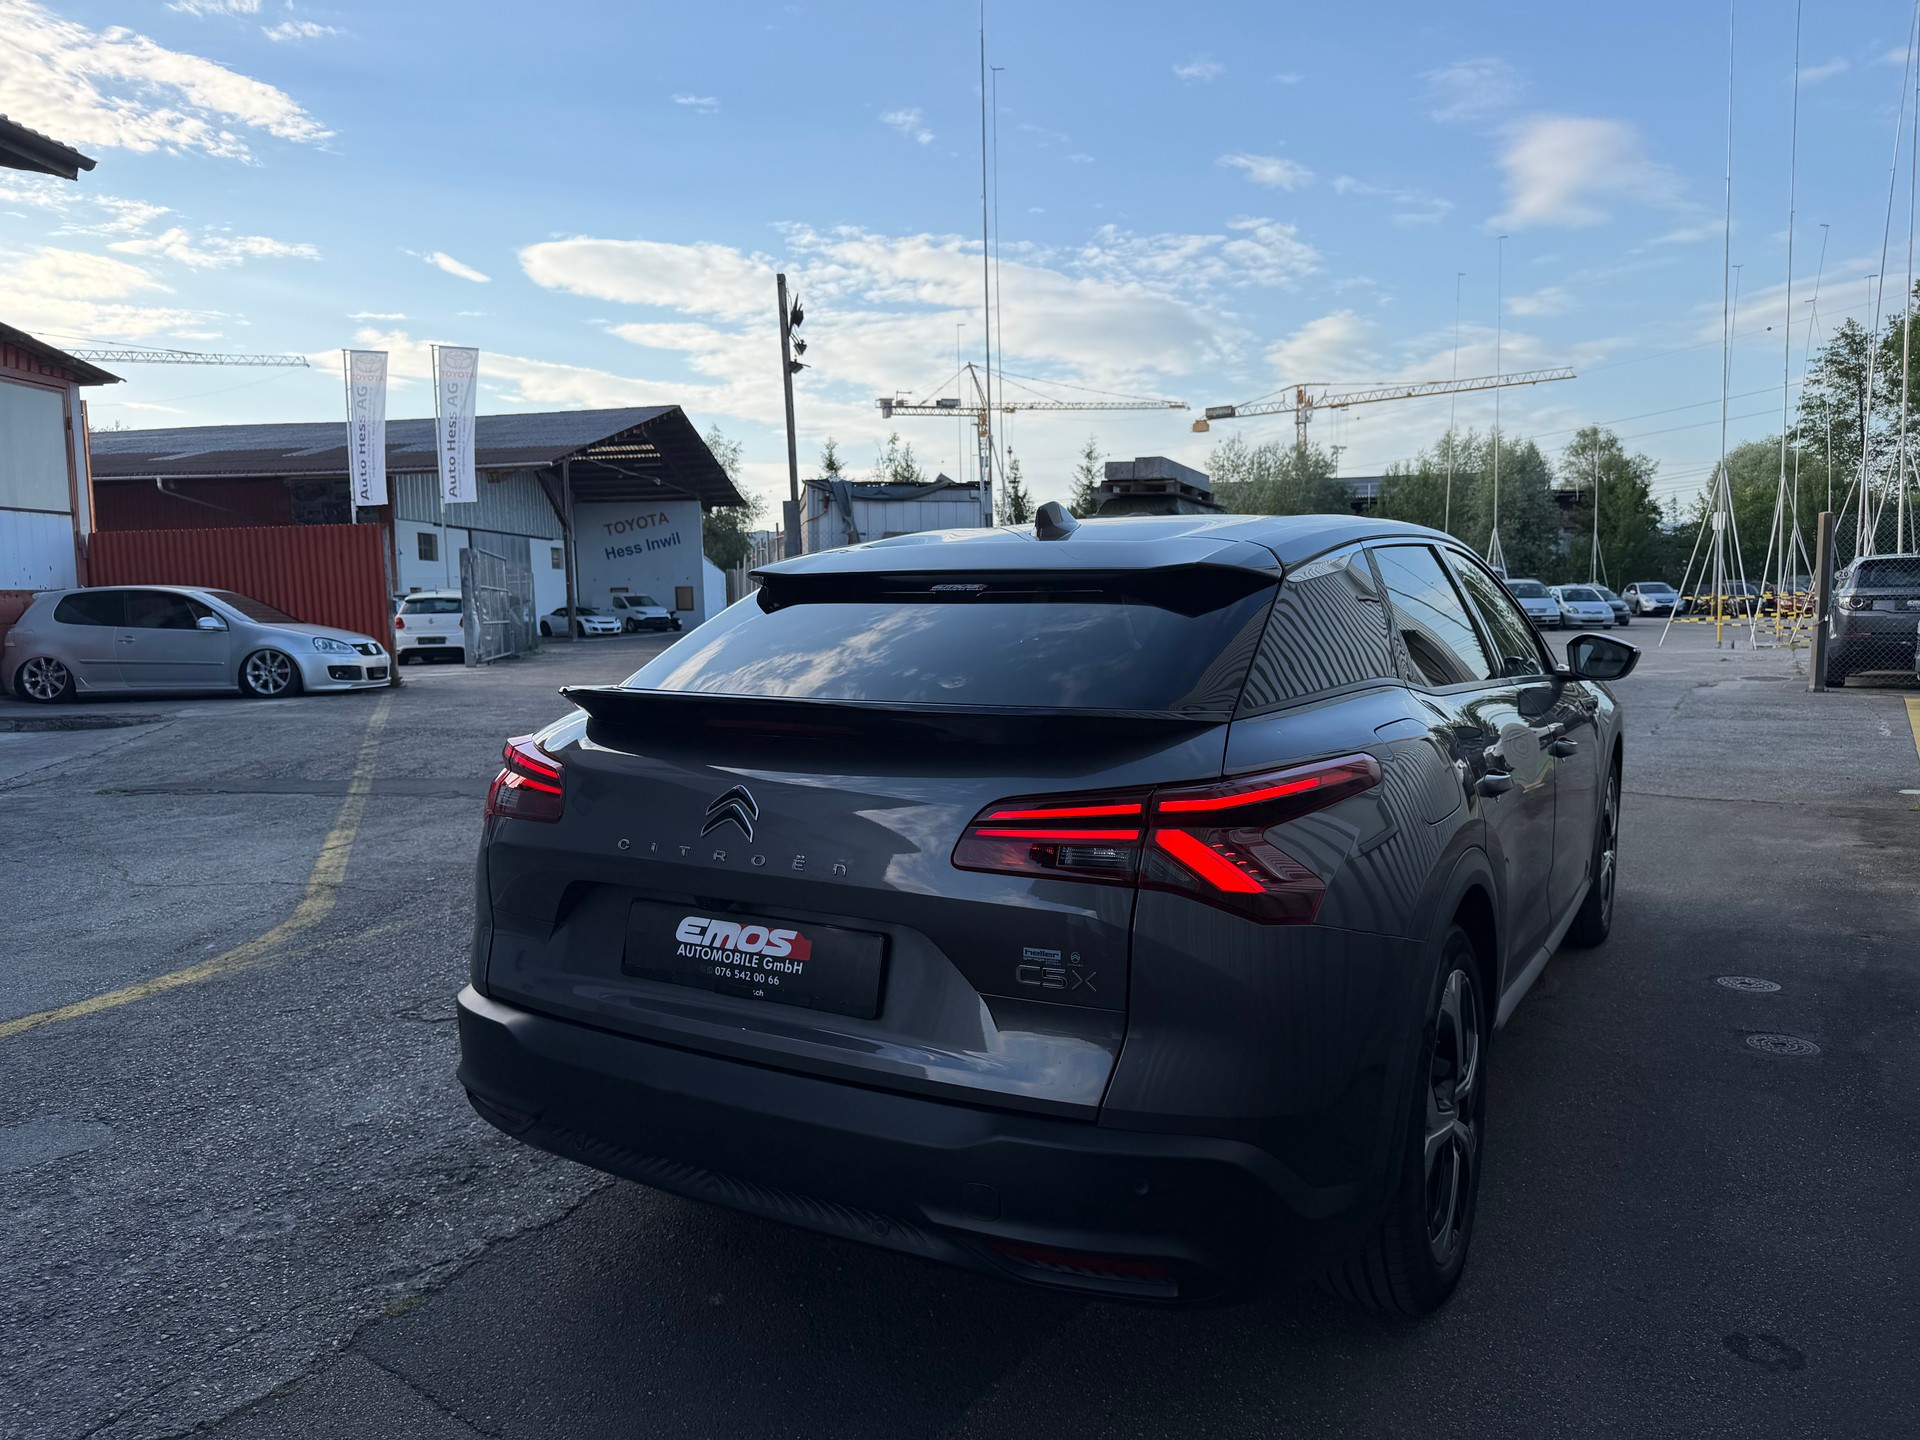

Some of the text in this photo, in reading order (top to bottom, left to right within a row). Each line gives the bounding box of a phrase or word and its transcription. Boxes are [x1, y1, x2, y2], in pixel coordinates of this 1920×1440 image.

[356, 386, 368, 411] AG
[447, 382, 459, 408] AG
[358, 414, 367, 455] Hess
[446, 411, 457, 452] Hess
[360, 460, 369, 500] Auto
[448, 456, 458, 498] Auto
[603, 511, 670, 537] TOYOTA
[604, 532, 681, 561] Hess Inwil
[676, 943, 803, 975] AUTOMOBILE GmbH
[1024, 949, 1060, 958] heller
[714, 966, 780, 986] 076 542 00 66
